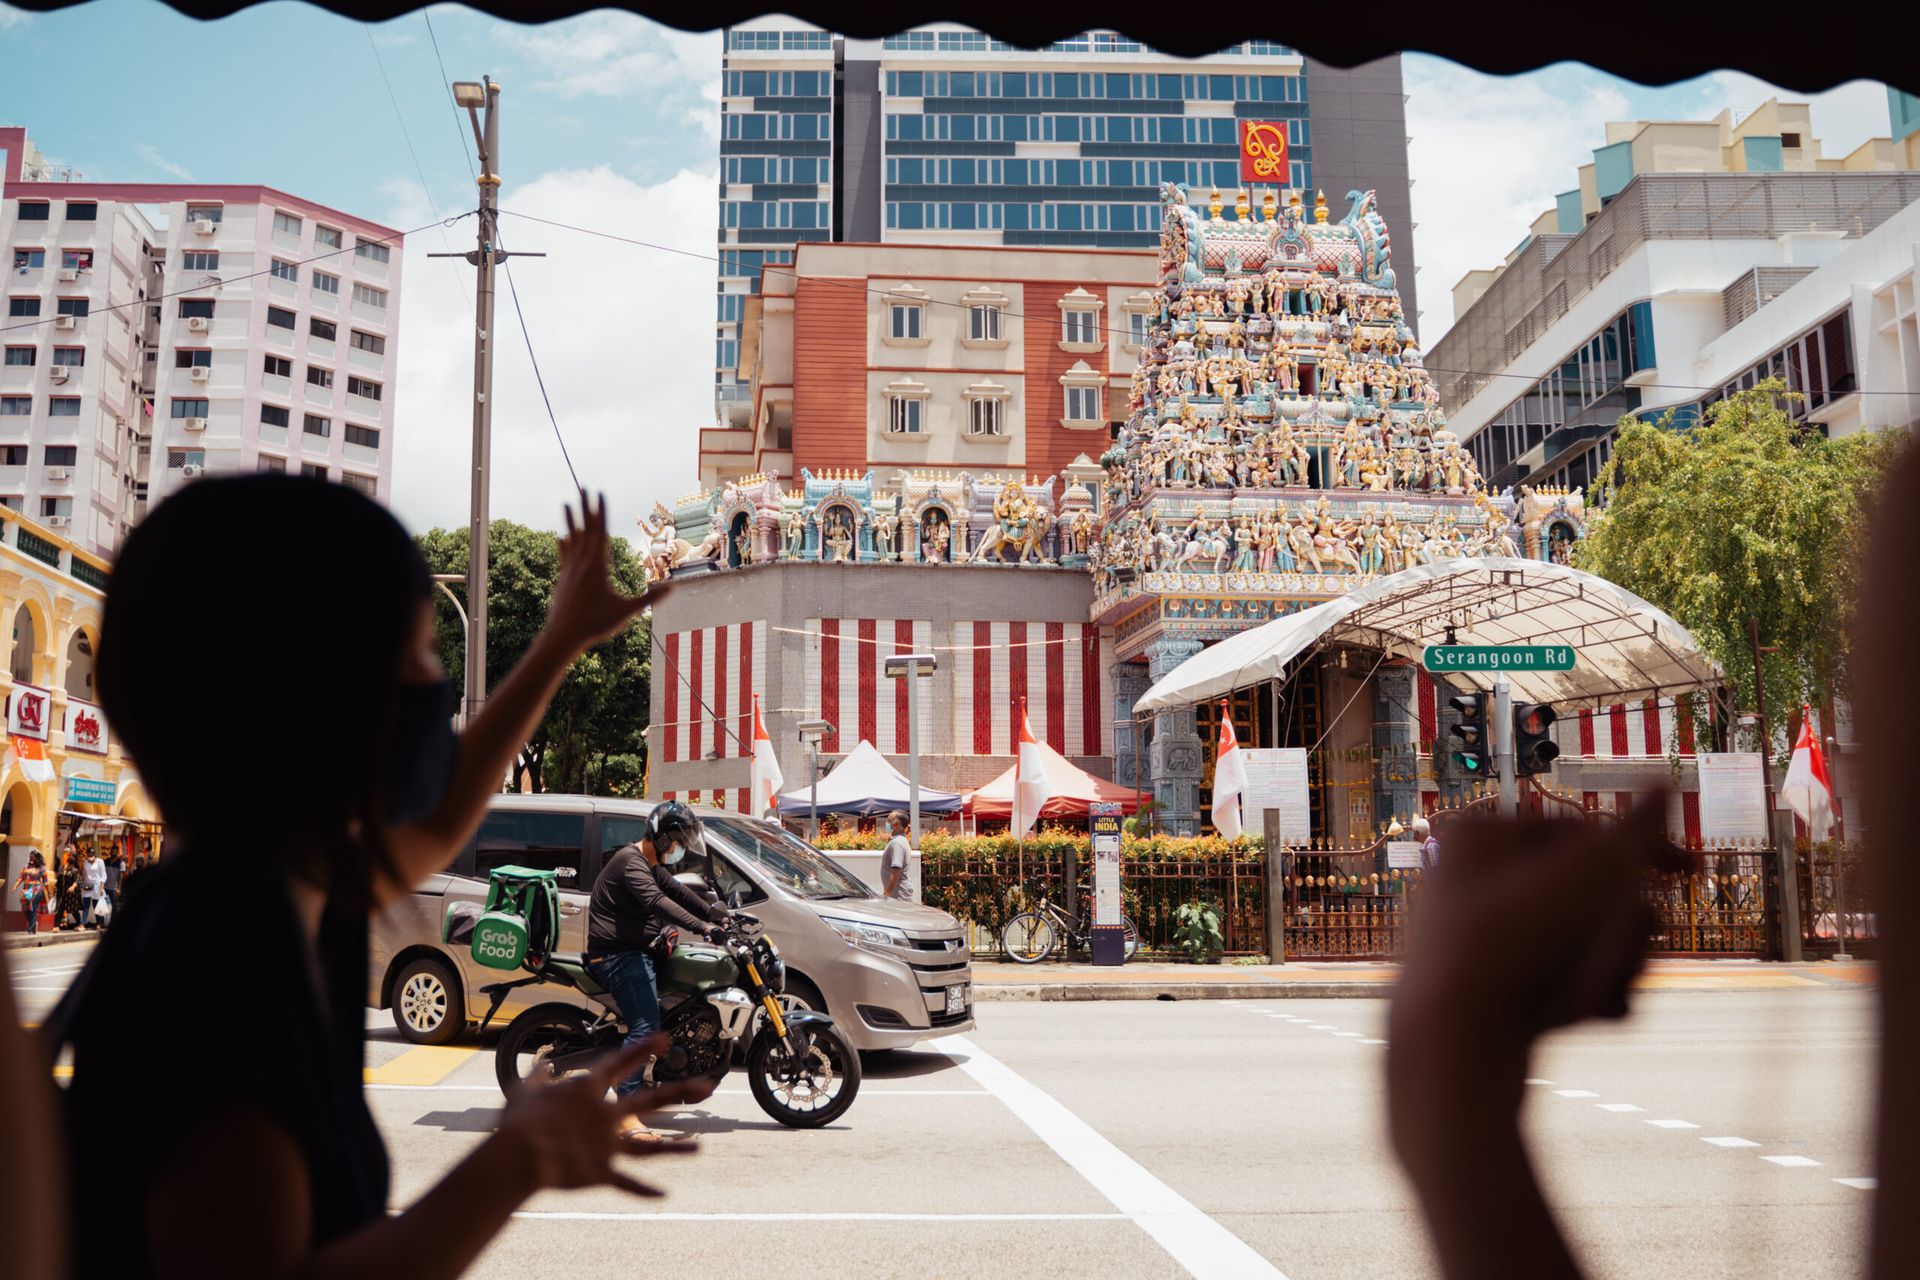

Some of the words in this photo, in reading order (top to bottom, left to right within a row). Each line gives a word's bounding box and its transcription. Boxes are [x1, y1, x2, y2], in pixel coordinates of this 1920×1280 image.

[1434, 648, 1534, 668] Serangoon
[1545, 648, 1567, 665] Rd
[1094, 822, 1119, 832] INDIA
[481, 929, 518, 946] Grab
[479, 941, 516, 959] Food
